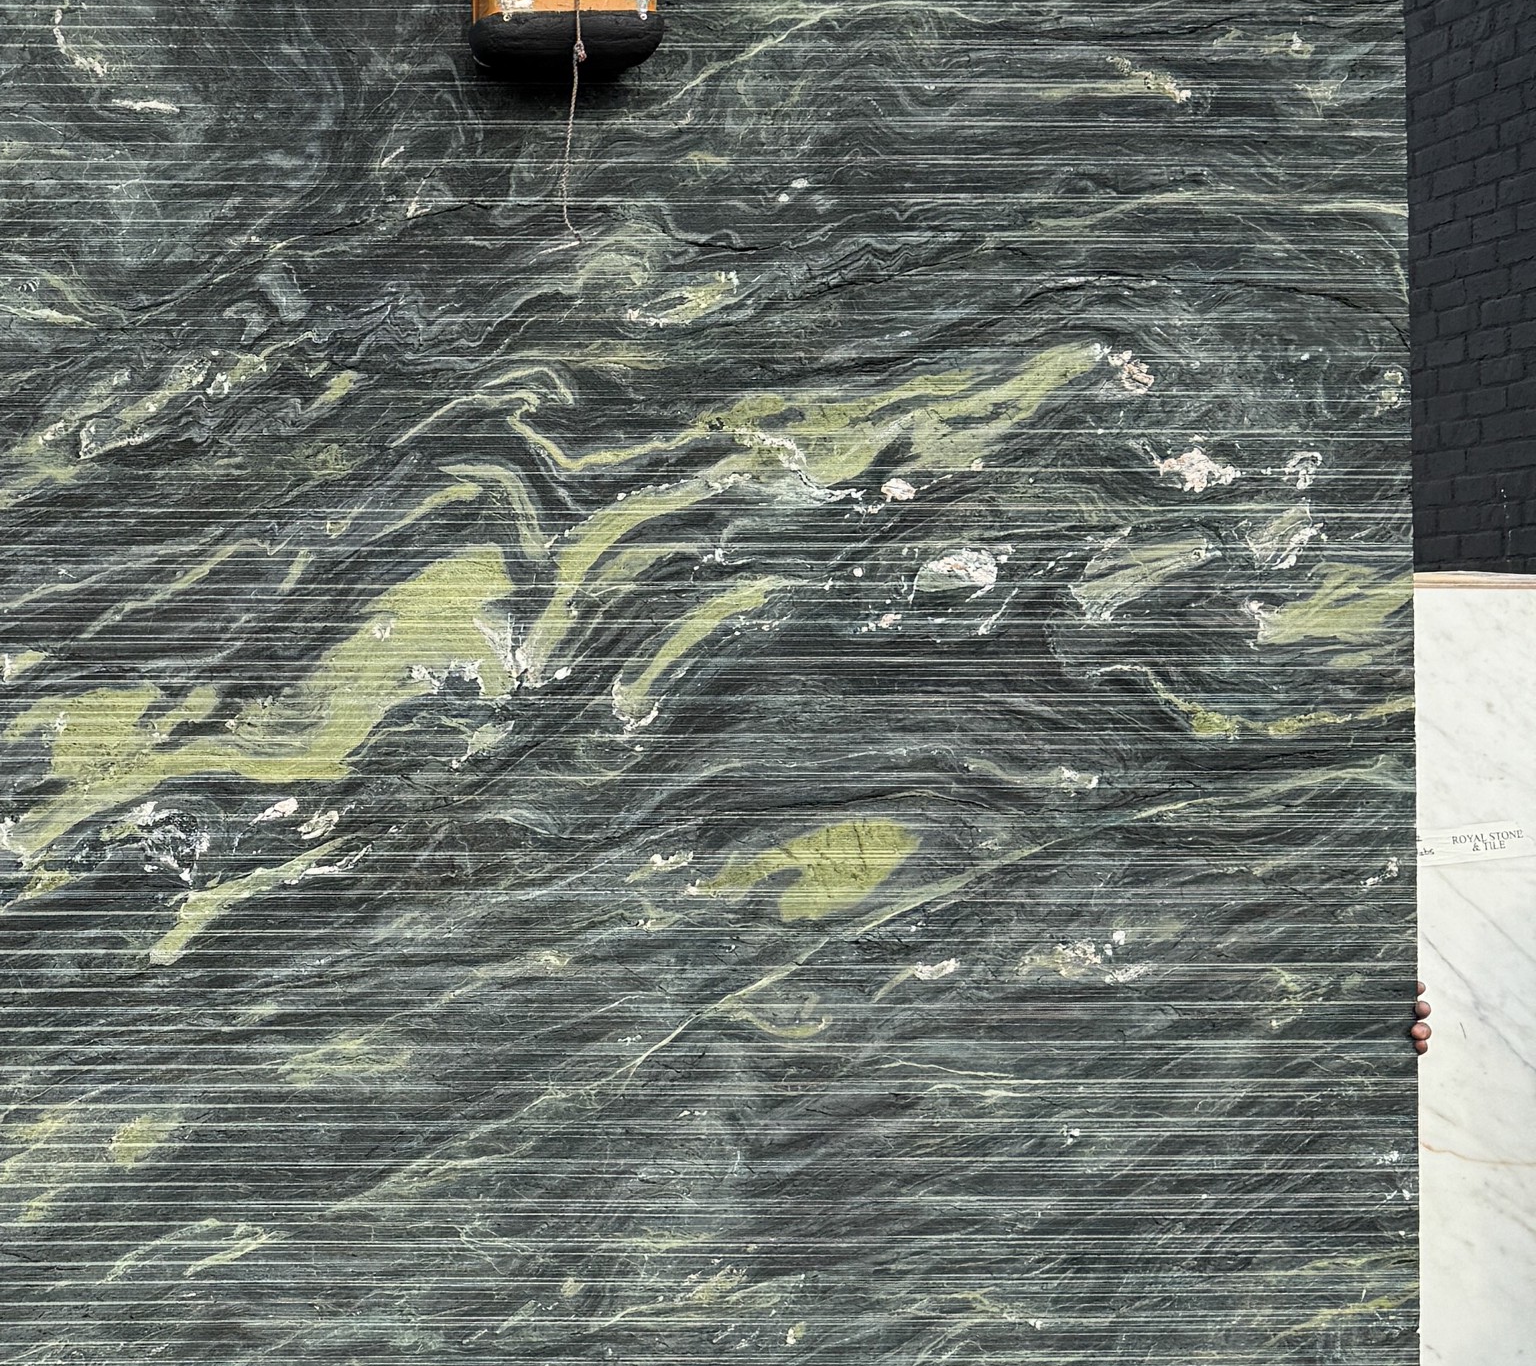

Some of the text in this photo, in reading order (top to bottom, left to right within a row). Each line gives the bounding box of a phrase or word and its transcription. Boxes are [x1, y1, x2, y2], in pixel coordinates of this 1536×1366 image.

[1452, 829, 1524, 845] ROYAL STONE
[1472, 840, 1506, 852] & TILE
